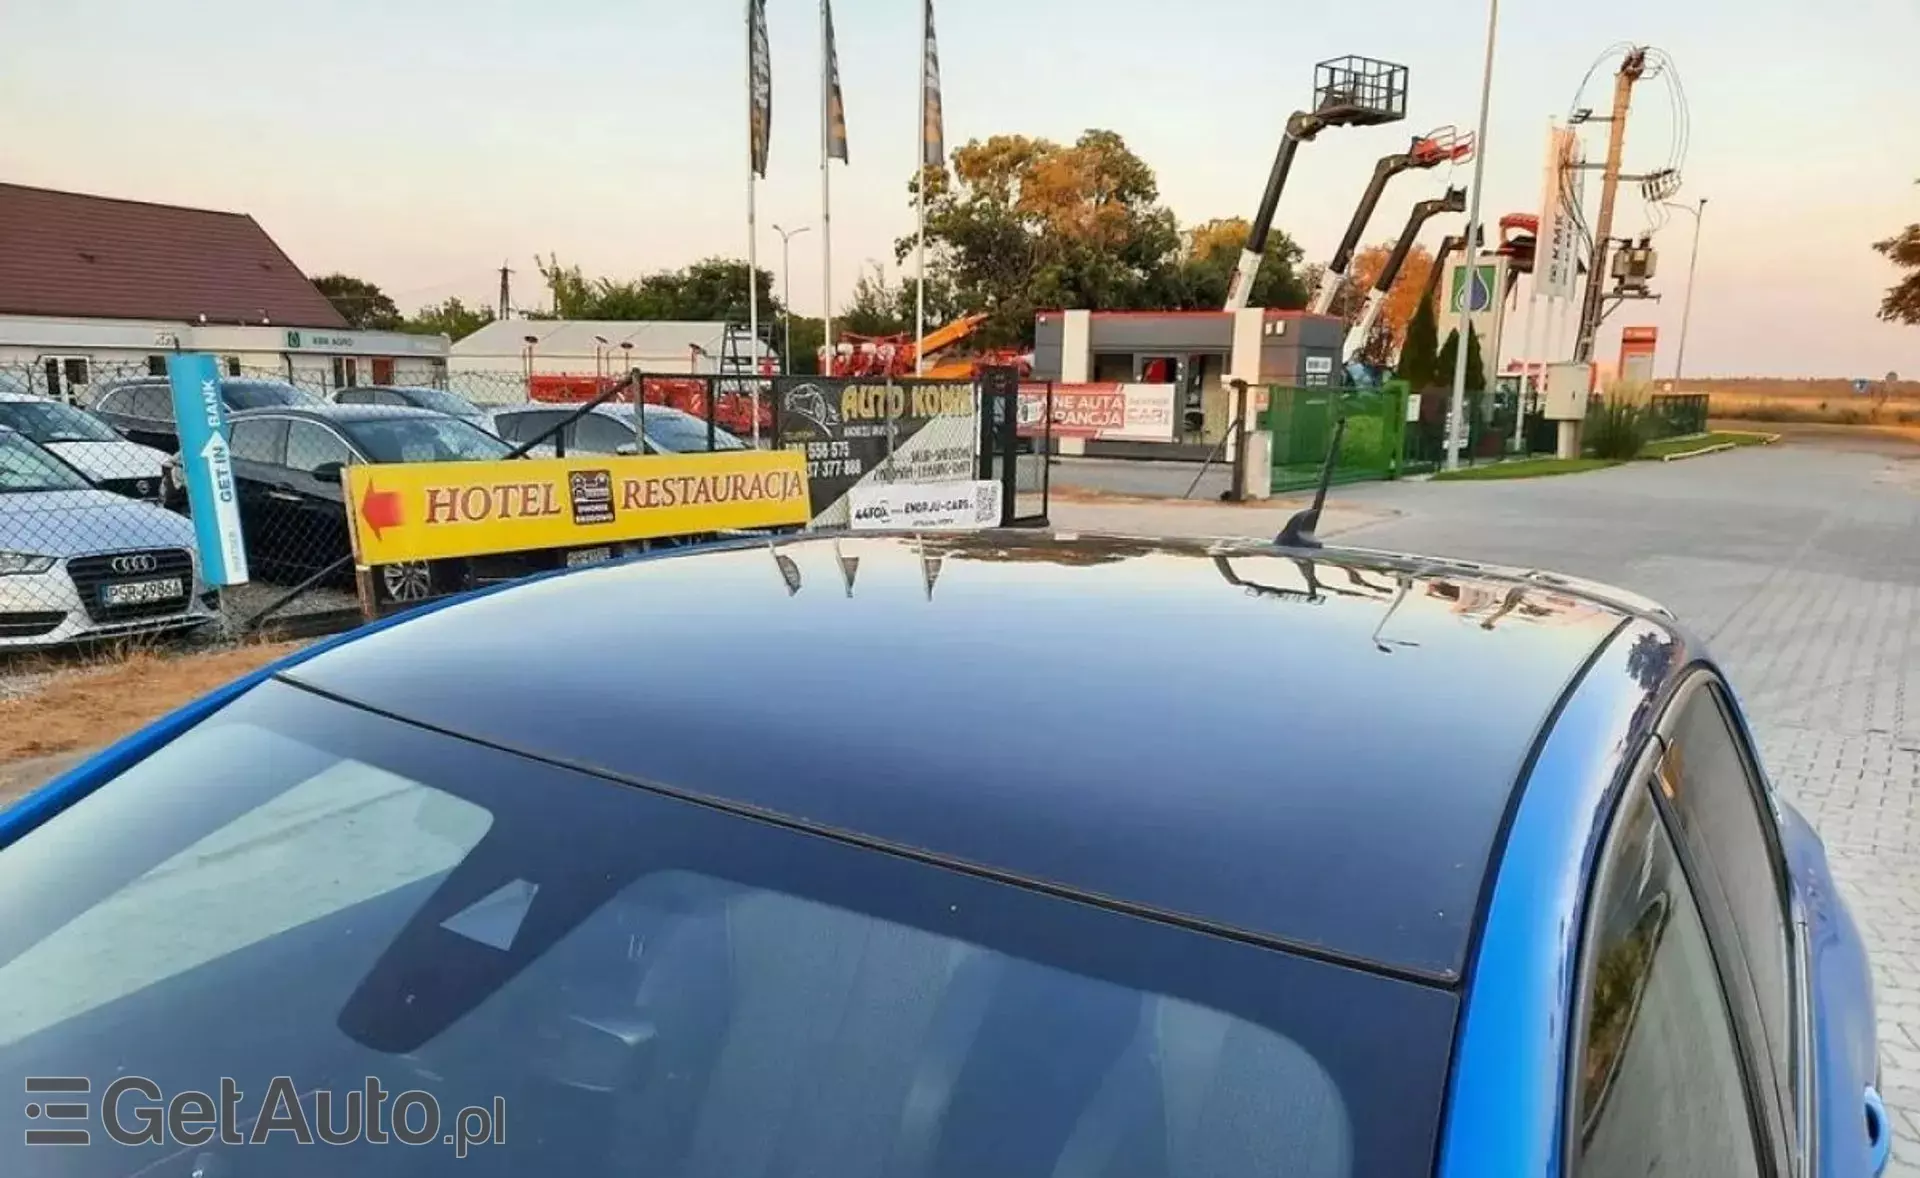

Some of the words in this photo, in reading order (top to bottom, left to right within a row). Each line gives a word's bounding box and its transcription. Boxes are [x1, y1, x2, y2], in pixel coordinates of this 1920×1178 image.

[201, 380, 221, 427] BANK
[842, 384, 905, 422] AUTO
[1077, 394, 1123, 409] AUTA
[425, 483, 561, 524] HOTEL
[620, 469, 803, 510] RESTAURACJA
